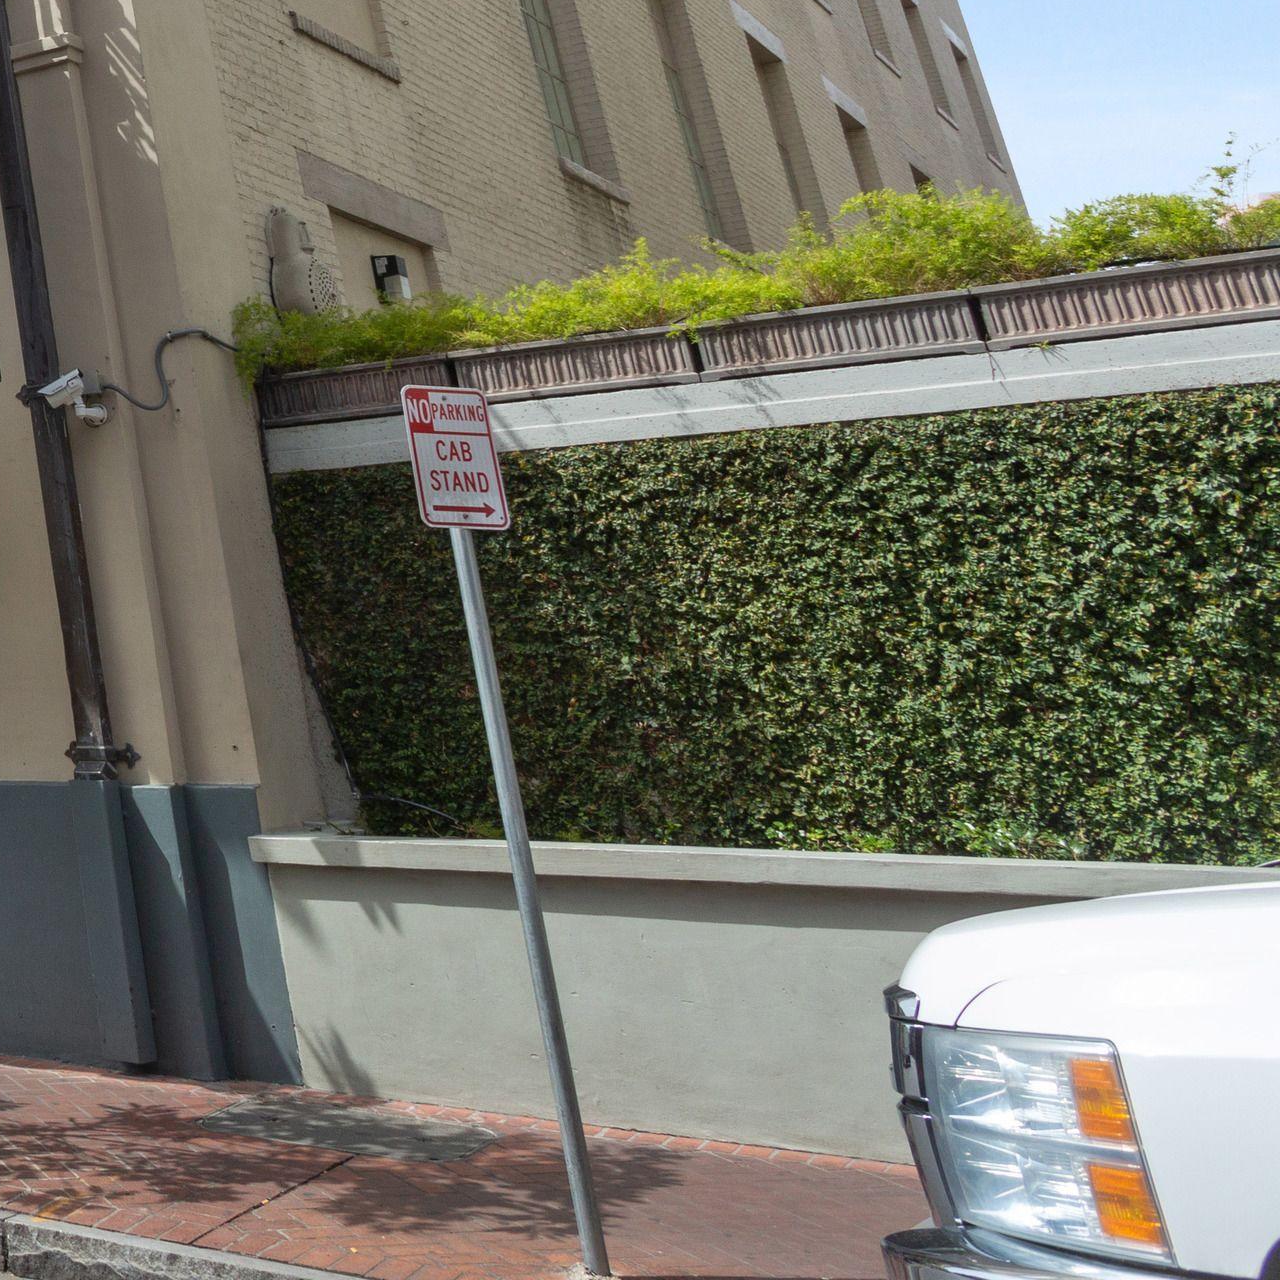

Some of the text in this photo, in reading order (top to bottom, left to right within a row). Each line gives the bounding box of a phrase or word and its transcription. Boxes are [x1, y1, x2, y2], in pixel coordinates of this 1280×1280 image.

[406, 397, 484, 424] NO PARKING
[436, 439, 473, 462] CAB
[430, 470, 489, 493] STAND
